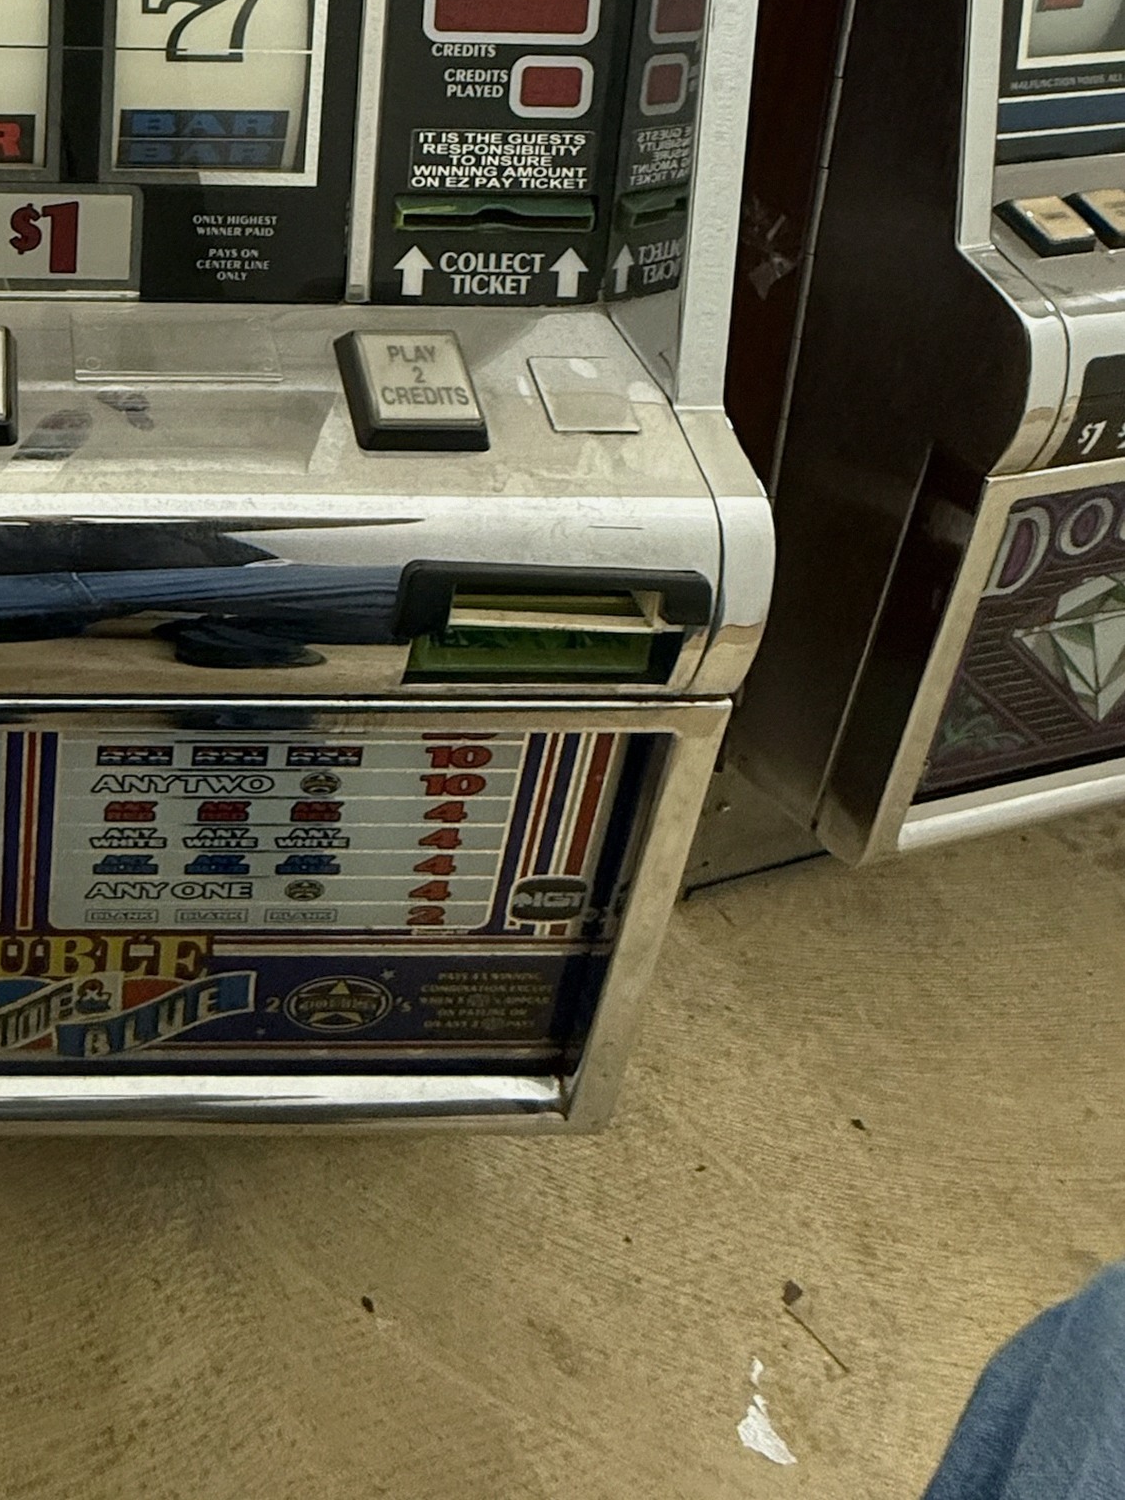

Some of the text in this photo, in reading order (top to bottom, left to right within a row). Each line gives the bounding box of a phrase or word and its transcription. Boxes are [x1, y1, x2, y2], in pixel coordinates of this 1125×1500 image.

[431, 43, 497, 57] CREDITS
[444, 68, 509, 84] CREDITS
[446, 84, 504, 98] PLAYED
[129, 113, 274, 136] BAR
[419, 132, 586, 145] IT IS THE GUESTS
[423, 143, 581, 156] RESPONSIBILITY
[449, 155, 552, 167] TO INSURE
[413, 165, 587, 178] WINNING AMOUNT
[411, 177, 587, 189] ON EZ PAY TICKET
[192, 215, 278, 225] ONLY HIGHEST
[8, 201, 80, 274] $1
[196, 226, 275, 236] WINNER PAID
[208, 248, 259, 258] PAYS ON
[196, 259, 270, 270] CENTER LINE
[439, 252, 546, 273] COLLECT
[216, 271, 248, 280] ONLY
[450, 274, 531, 295] TICKET
[386, 345, 436, 362] PLAY
[412, 365, 426, 384] 2
[381, 386, 470, 405] CREDITS
[1077, 419, 1107, 455] $1
[425, 745, 492, 768] 10
[92, 775, 275, 794] ANY TWO
[420, 773, 486, 796] 10
[86, 881, 253, 899] ANY ONE
[76, 979, 112, 1016] &
[83, 987, 223, 1058] BLUE
